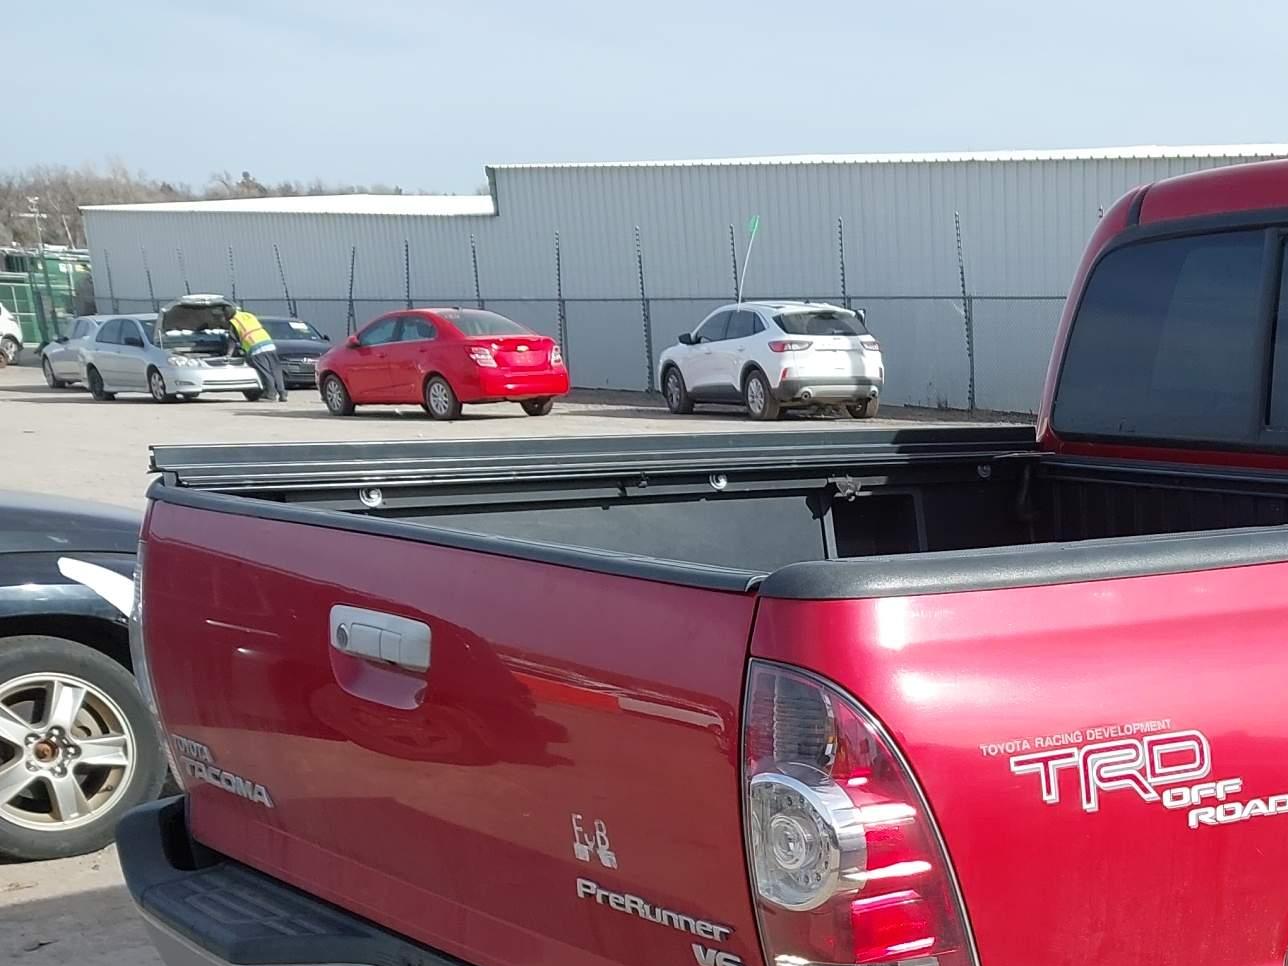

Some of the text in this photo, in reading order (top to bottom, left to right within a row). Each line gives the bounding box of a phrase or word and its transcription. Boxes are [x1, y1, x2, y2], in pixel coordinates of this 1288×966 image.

[980, 719, 1173, 757] TOYOTA RACING DEVELOPMENT
[180, 754, 275, 808] TACOMA
[1010, 730, 1212, 812] TRD
[1162, 777, 1243, 809] OFF
[576, 877, 734, 942] PreRunner
